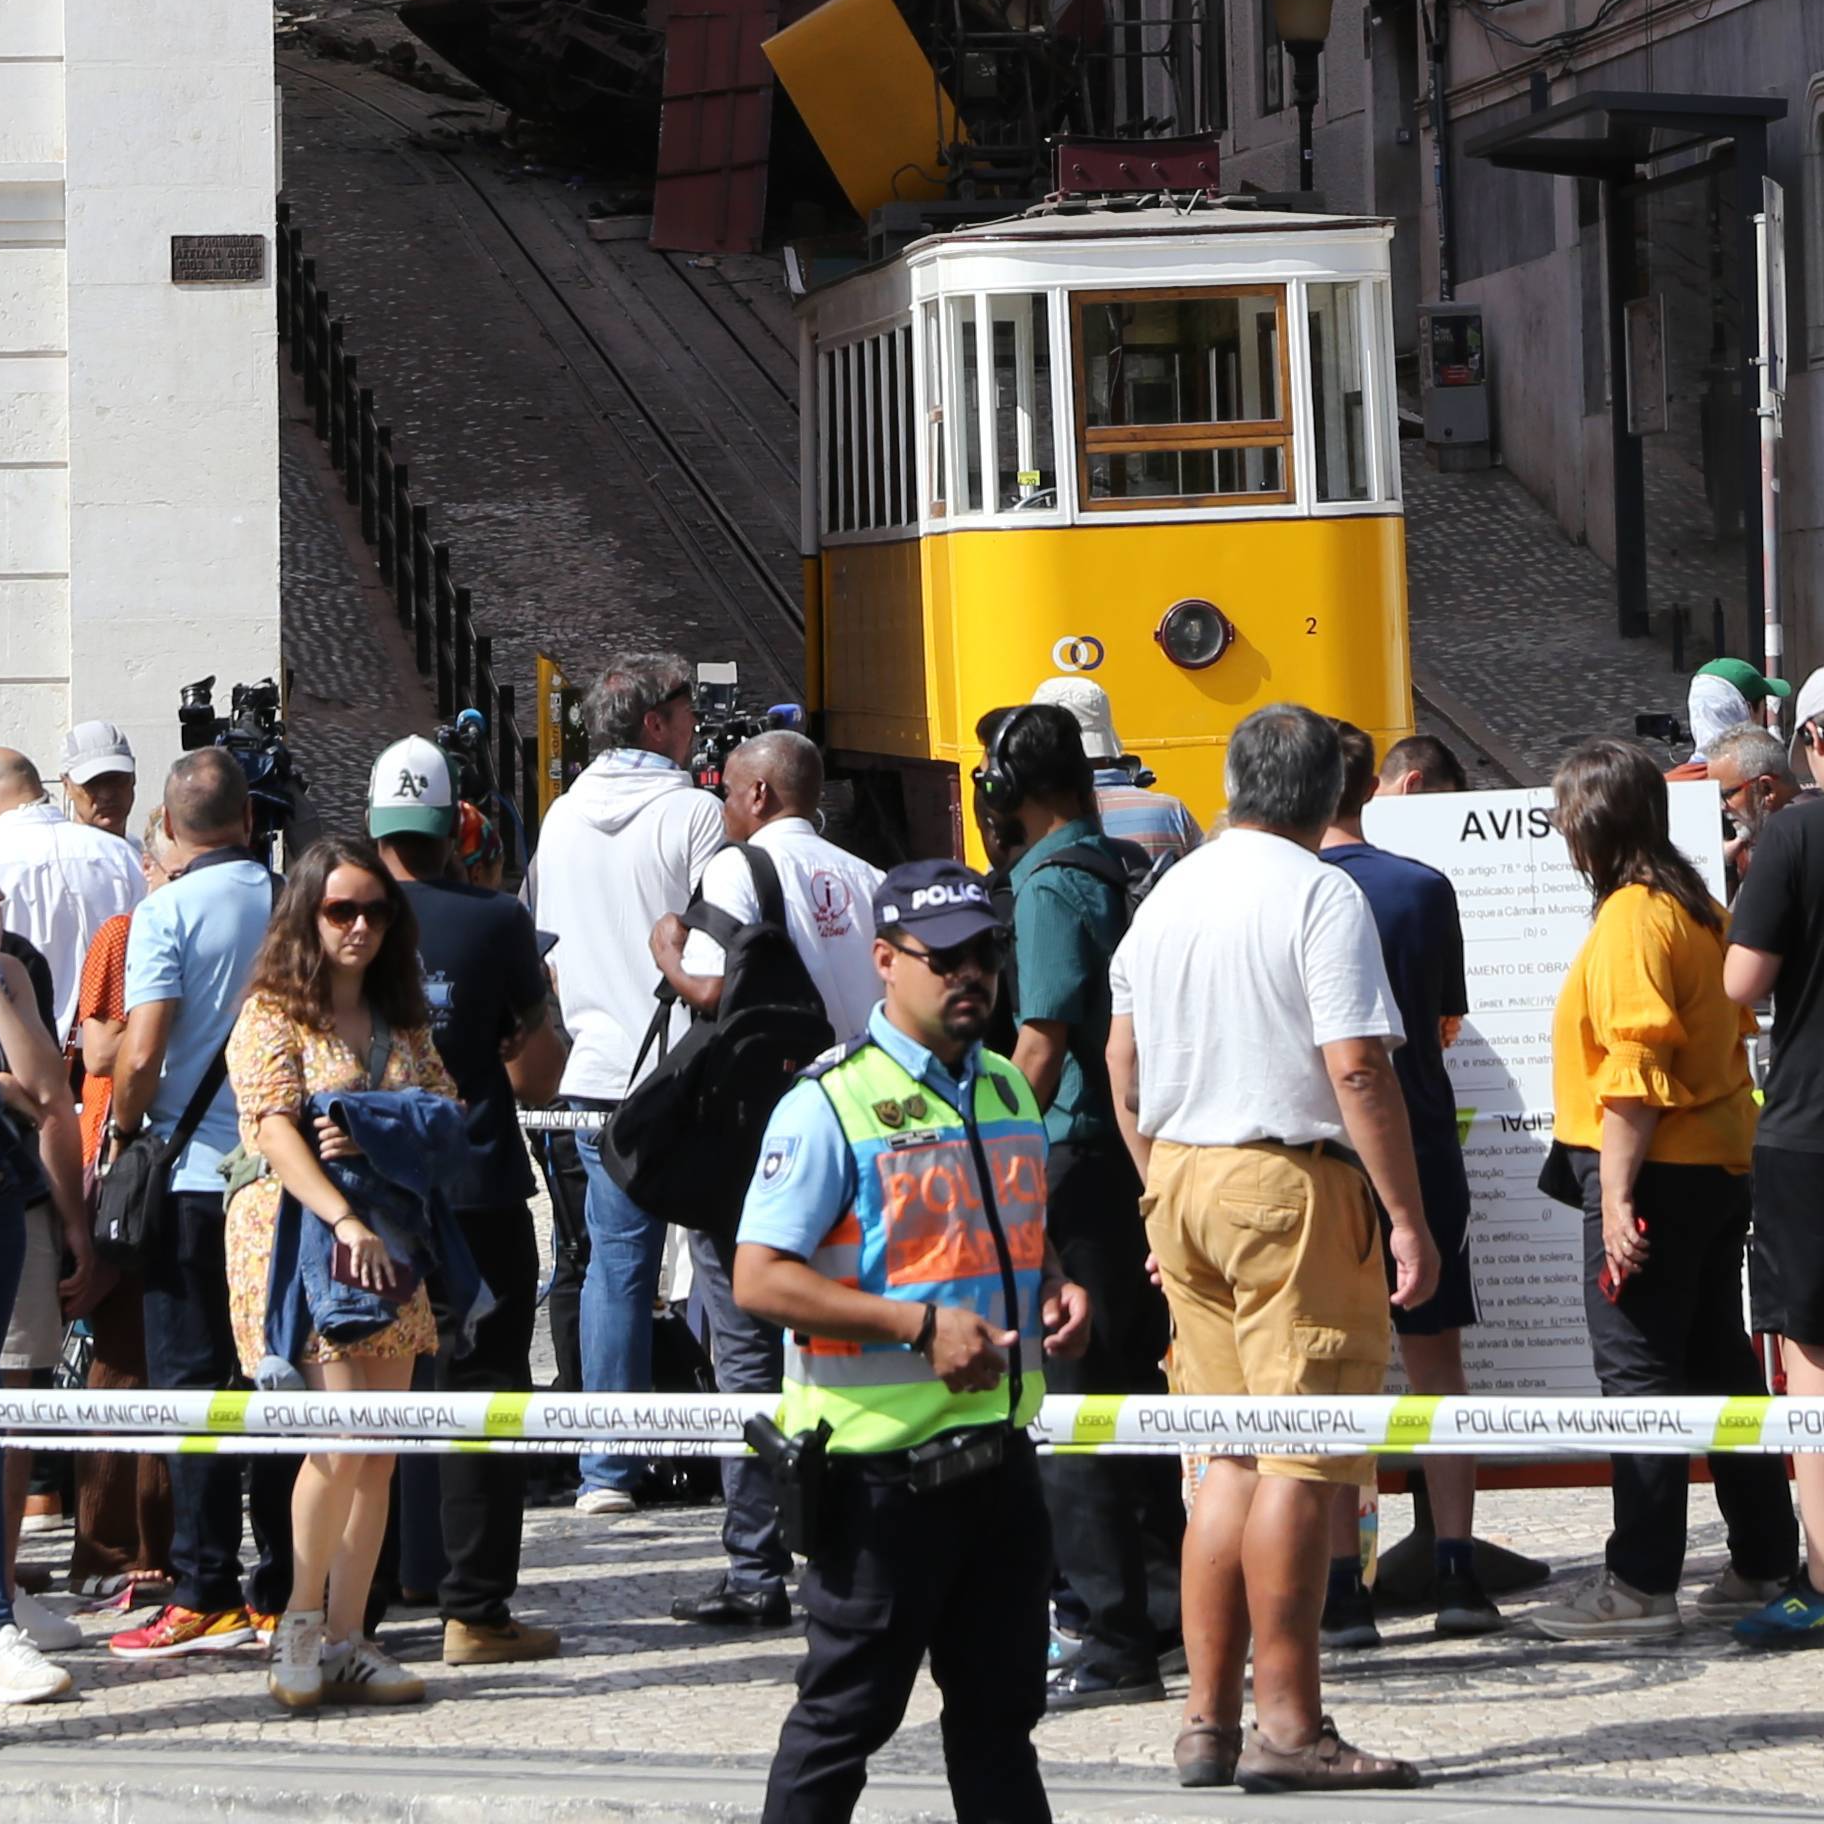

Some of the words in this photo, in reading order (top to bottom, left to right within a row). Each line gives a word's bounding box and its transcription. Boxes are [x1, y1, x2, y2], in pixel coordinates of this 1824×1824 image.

[1306, 617, 1317, 634] 2
[1460, 807, 1552, 841] AVIS
[1468, 863, 1497, 876] artigo
[1541, 861, 1577, 872] Decre
[1518, 886, 1539, 898] pelo
[1505, 903, 1545, 916] Câmara
[1524, 927, 1537, 939] (b)
[1518, 963, 1535, 974] DE
[1455, 1034, 1520, 1047] onservatória
[1523, 1035, 1536, 1044] do
[1473, 1056, 1509, 1067] inscrito
[1512, 1057, 1525, 1065] na
[1477, 1232, 1490, 1242] do
[1493, 1230, 1529, 1241] edifício
[1482, 1255, 1495, 1264] da
[1498, 1254, 1519, 1263] cota
[1523, 1253, 1536, 1262] de
[1540, 1250, 1573, 1262] soleira
[1488, 1277, 1500, 1285] da
[1503, 1275, 1524, 1284] cota
[1528, 1274, 1540, 1283] de
[1544, 1272, 1577, 1282] soleira
[1507, 1292, 1559, 1307] edificação
[1478, 1336, 1508, 1349] alvará
[1512, 1337, 1524, 1347] de
[1528, 1333, 1585, 1346] loteamento
[1495, 1377, 1514, 1388] das
[1517, 1375, 1546, 1387] obras
[77, 1403, 189, 1426] MUNICIPAL
[264, 1401, 342, 1426] POLÍCIA
[350, 1406, 467, 1429] MUNICIPAL
[544, 1402, 628, 1429] POLÍCIA
[1139, 1404, 1226, 1433] POLÍCIA
[1236, 1409, 1366, 1433] MUNICIPAL
[1456, 1405, 1549, 1434] POLÍCIA
[1557, 1410, 1693, 1434] MUNICIPAL
[1718, 1416, 1760, 1428] LISBOA
